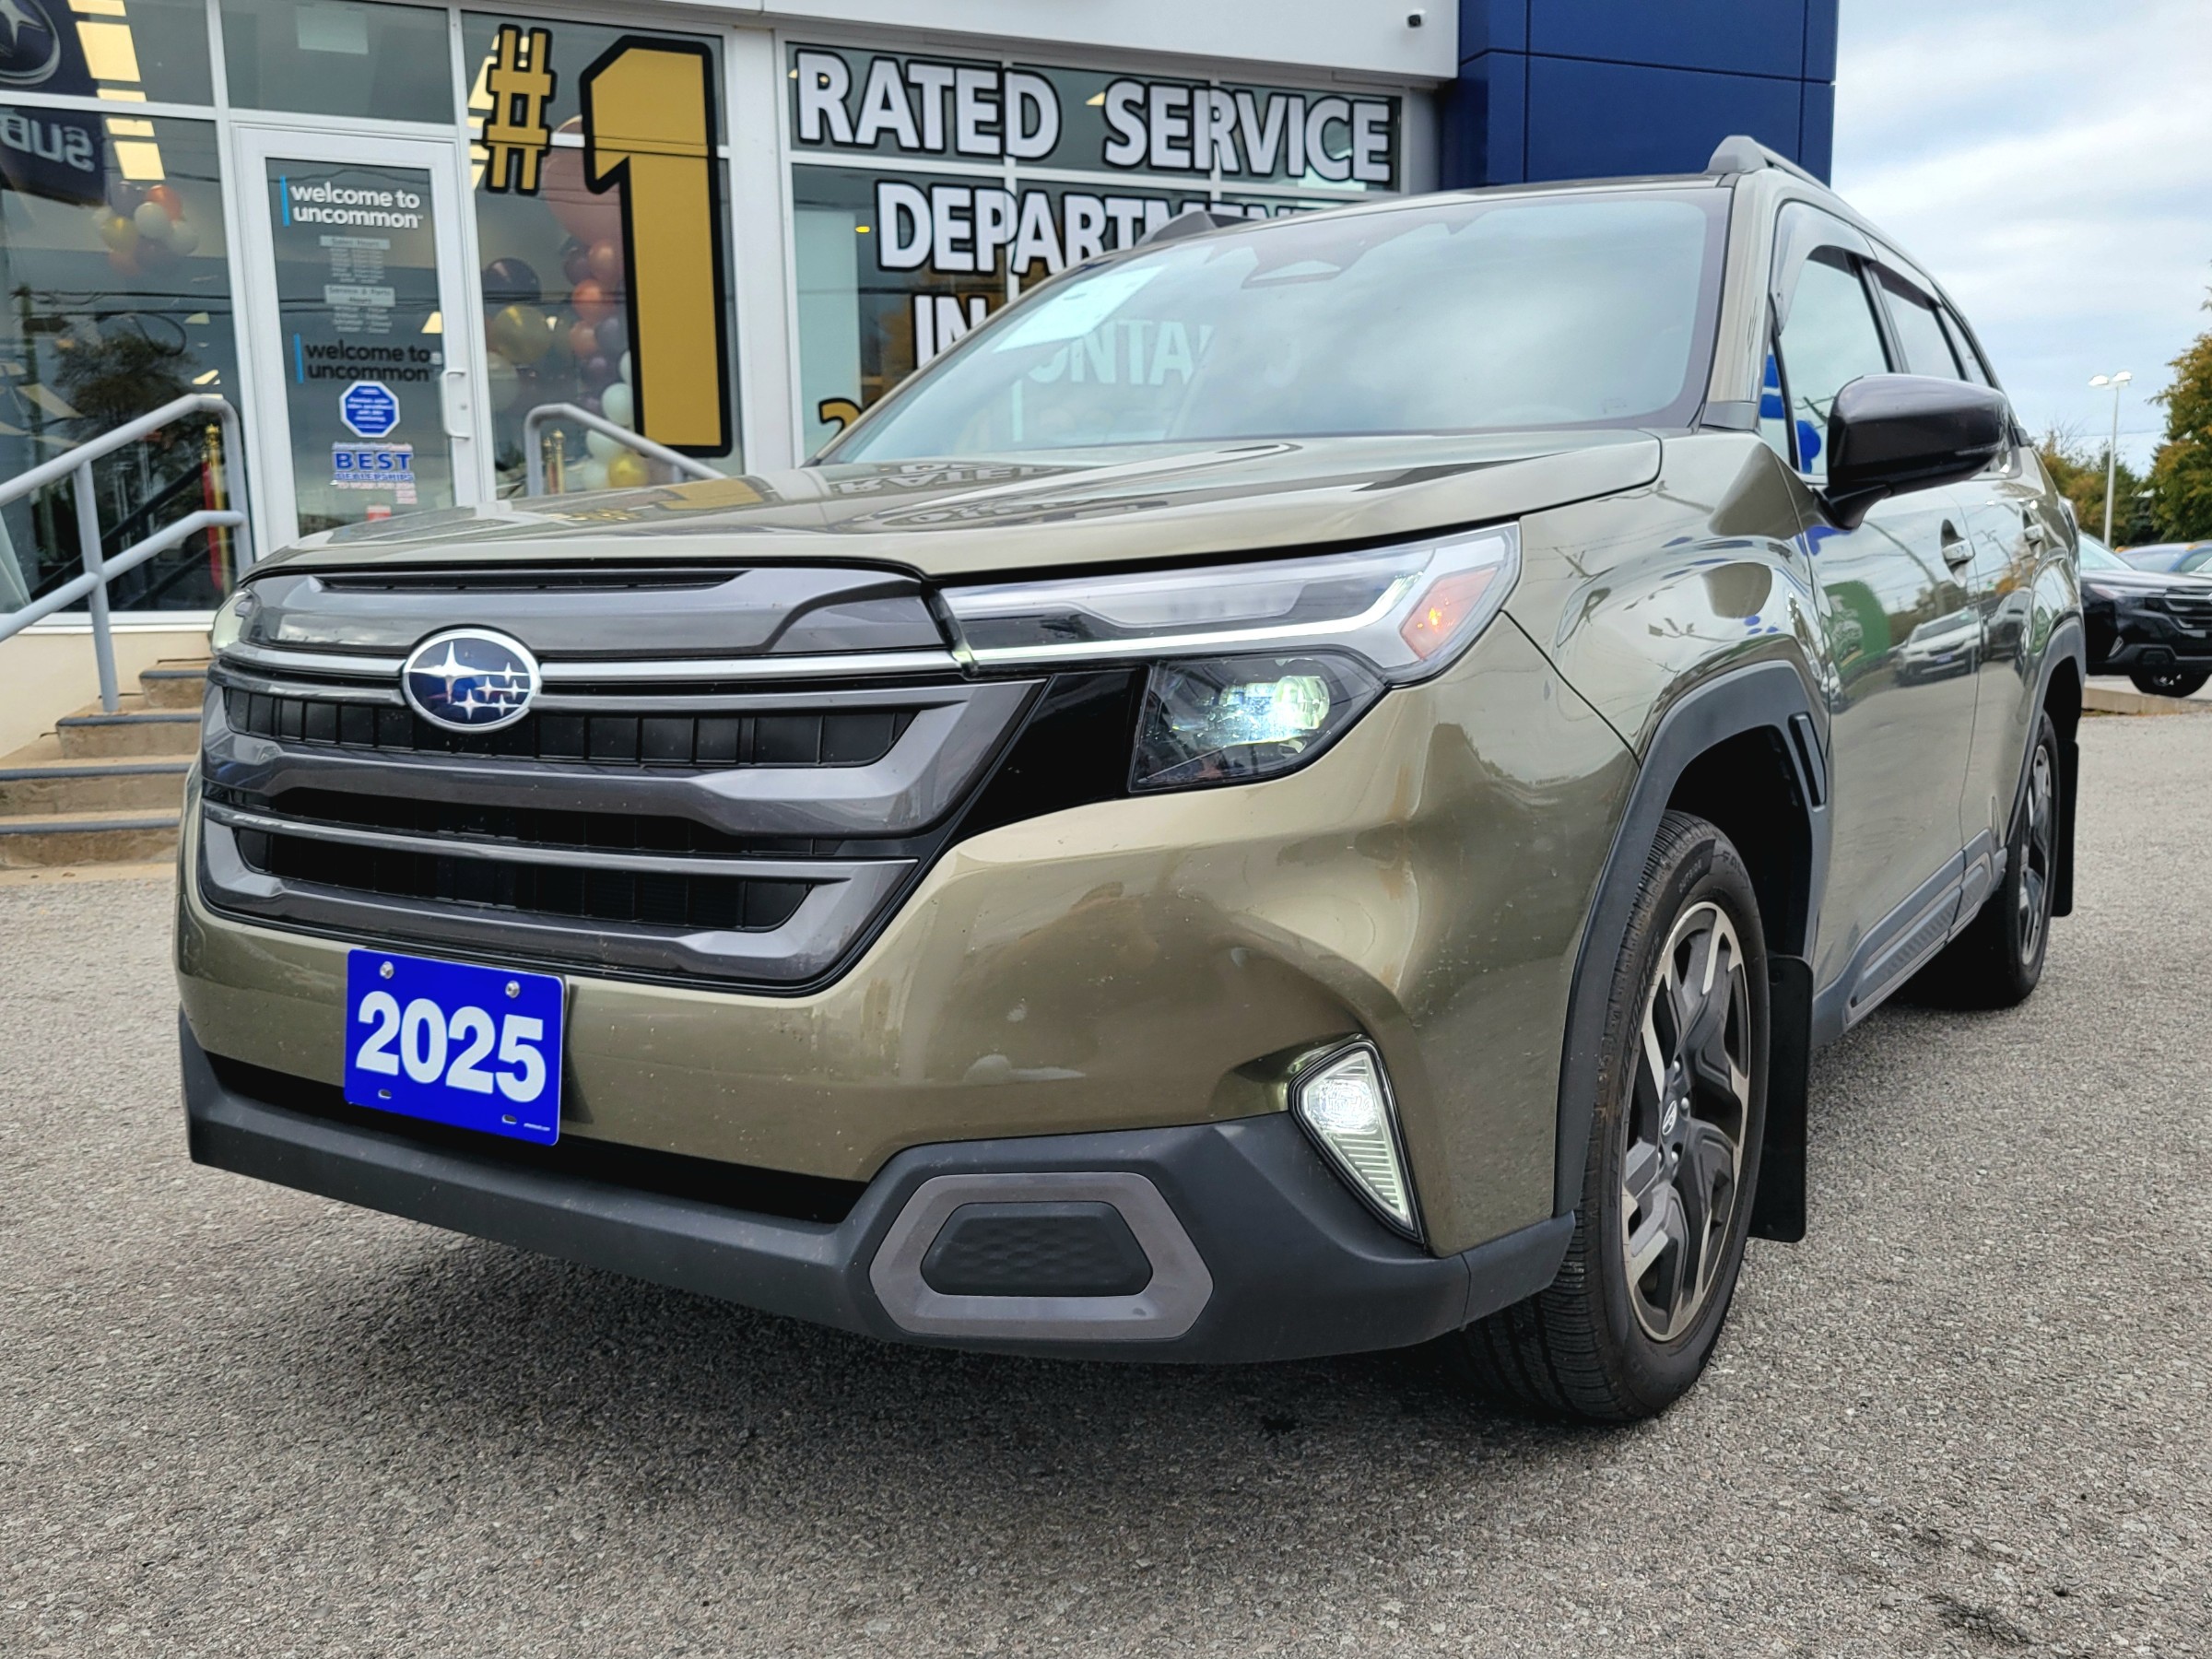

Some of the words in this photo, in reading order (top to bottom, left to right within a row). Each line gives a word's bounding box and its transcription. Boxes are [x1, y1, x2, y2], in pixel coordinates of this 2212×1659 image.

[795, 49, 1061, 159] RATED
[1103, 76, 1393, 183] SERVICE
[289, 182, 394, 207] welcome
[394, 189, 420, 209] to
[292, 205, 419, 229] uncommon
[484, 24, 733, 459] #1
[874, 179, 1325, 276] DEPART
[304, 339, 405, 364] welcome
[407, 344, 431, 364] to
[911, 291, 989, 371] IN
[307, 362, 430, 382] uncommon
[334, 452, 414, 471] BEST
[356, 990, 547, 1103] 2025
